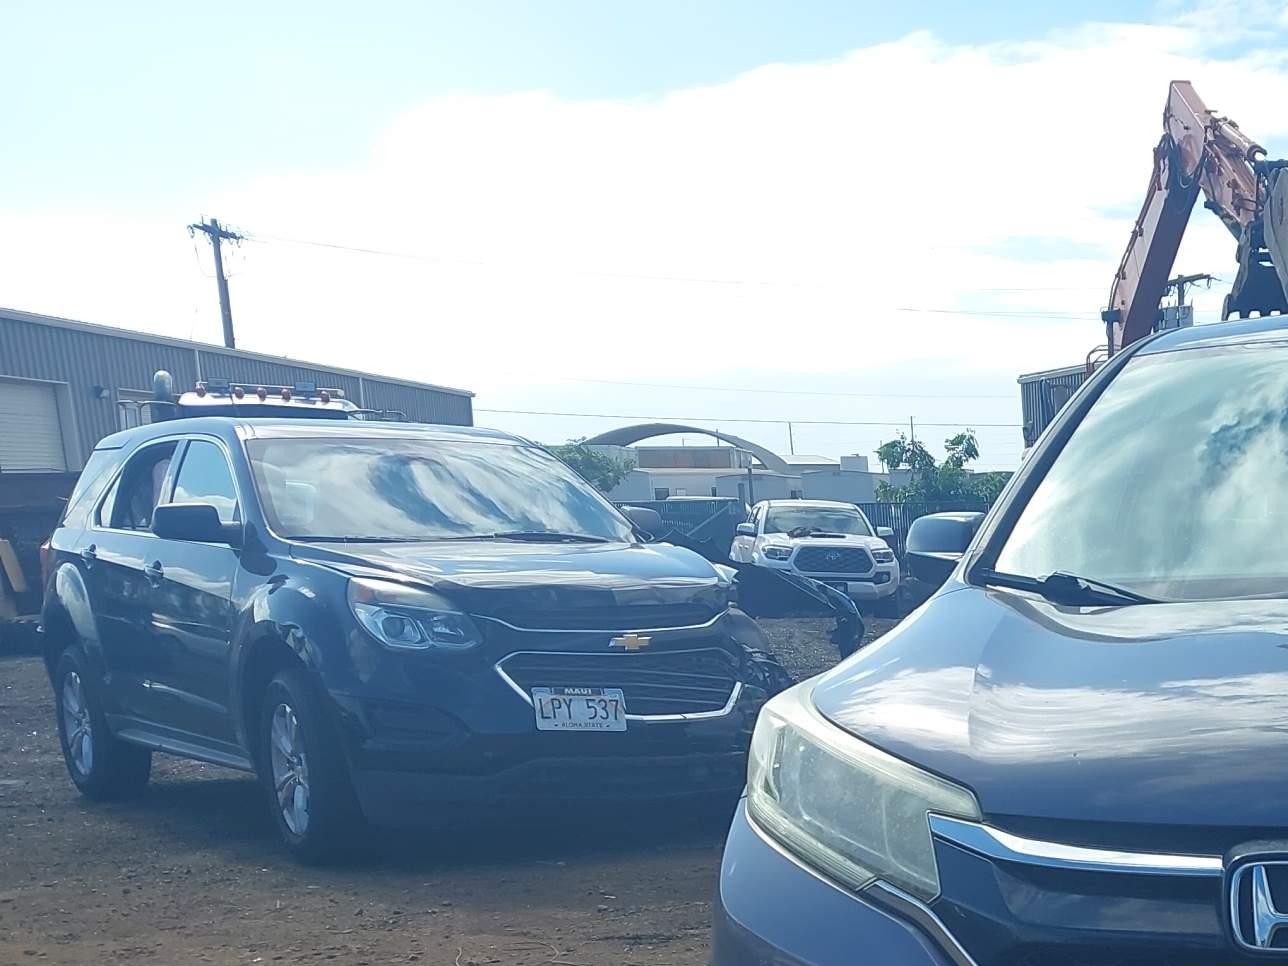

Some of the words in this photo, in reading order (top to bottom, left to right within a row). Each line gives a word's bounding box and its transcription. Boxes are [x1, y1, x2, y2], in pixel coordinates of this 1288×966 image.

[564, 687, 592, 695] MAUI
[538, 698, 573, 720] LPY
[585, 699, 619, 721] 537
